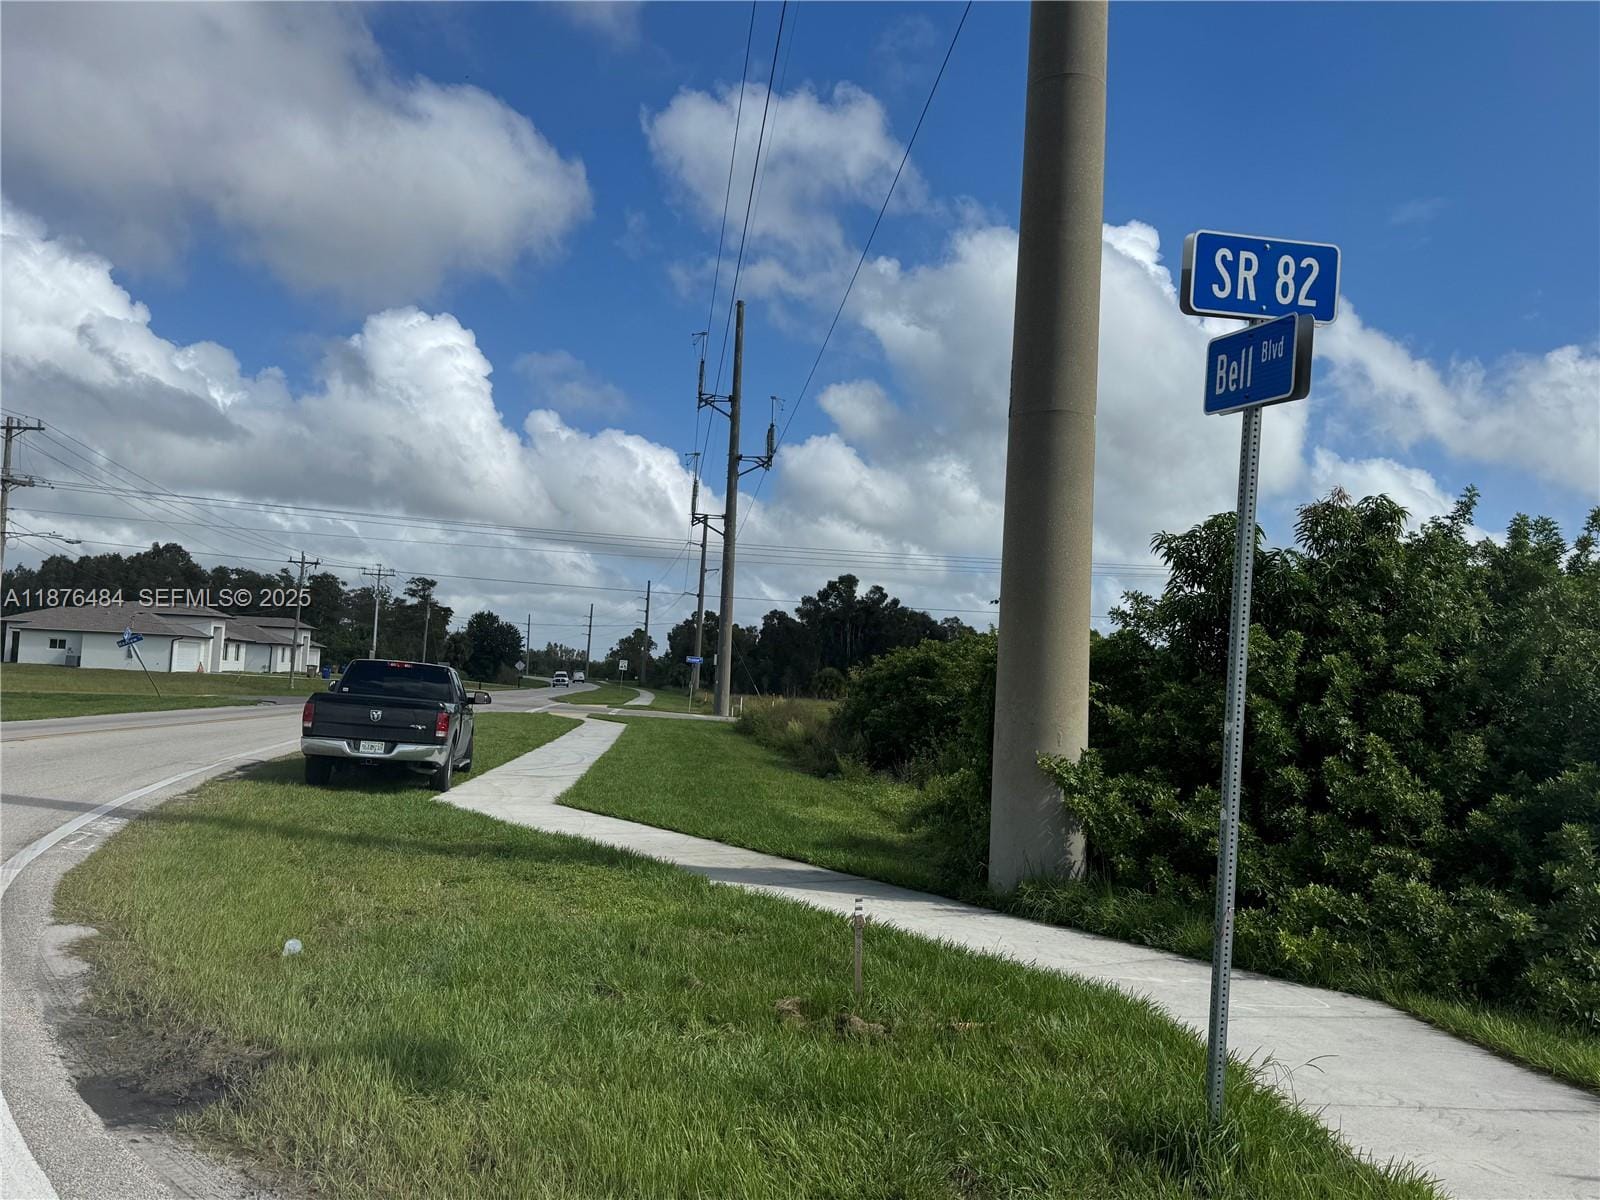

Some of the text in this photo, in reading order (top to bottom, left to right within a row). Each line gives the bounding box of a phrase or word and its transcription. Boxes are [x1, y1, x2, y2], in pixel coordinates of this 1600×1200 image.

[1212, 248, 1320, 307] SR 82
[1215, 335, 1285, 395] Bell Blvd
